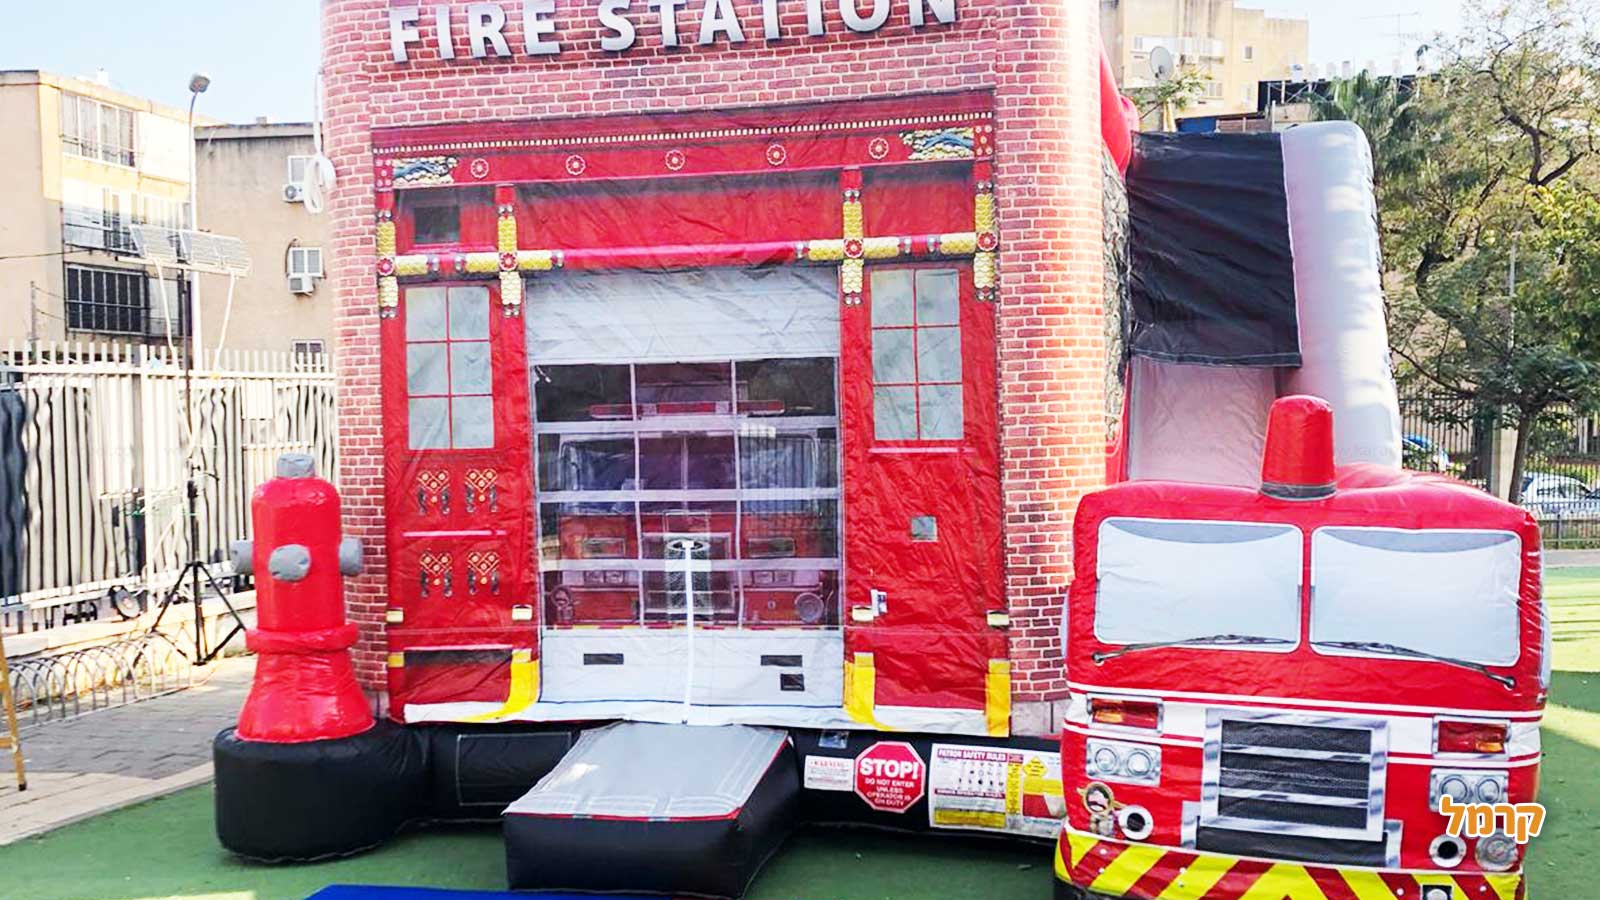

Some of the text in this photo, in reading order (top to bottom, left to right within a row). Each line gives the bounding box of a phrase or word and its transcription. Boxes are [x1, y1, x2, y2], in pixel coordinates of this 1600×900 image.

[389, 0, 562, 62] FIRE
[963, 750, 985, 760] SAFETY
[860, 757, 919, 780] STOP!
[892, 780, 915, 788] ENTER
[876, 786, 904, 794] UNLESS
[866, 791, 904, 800] OPERATOR
